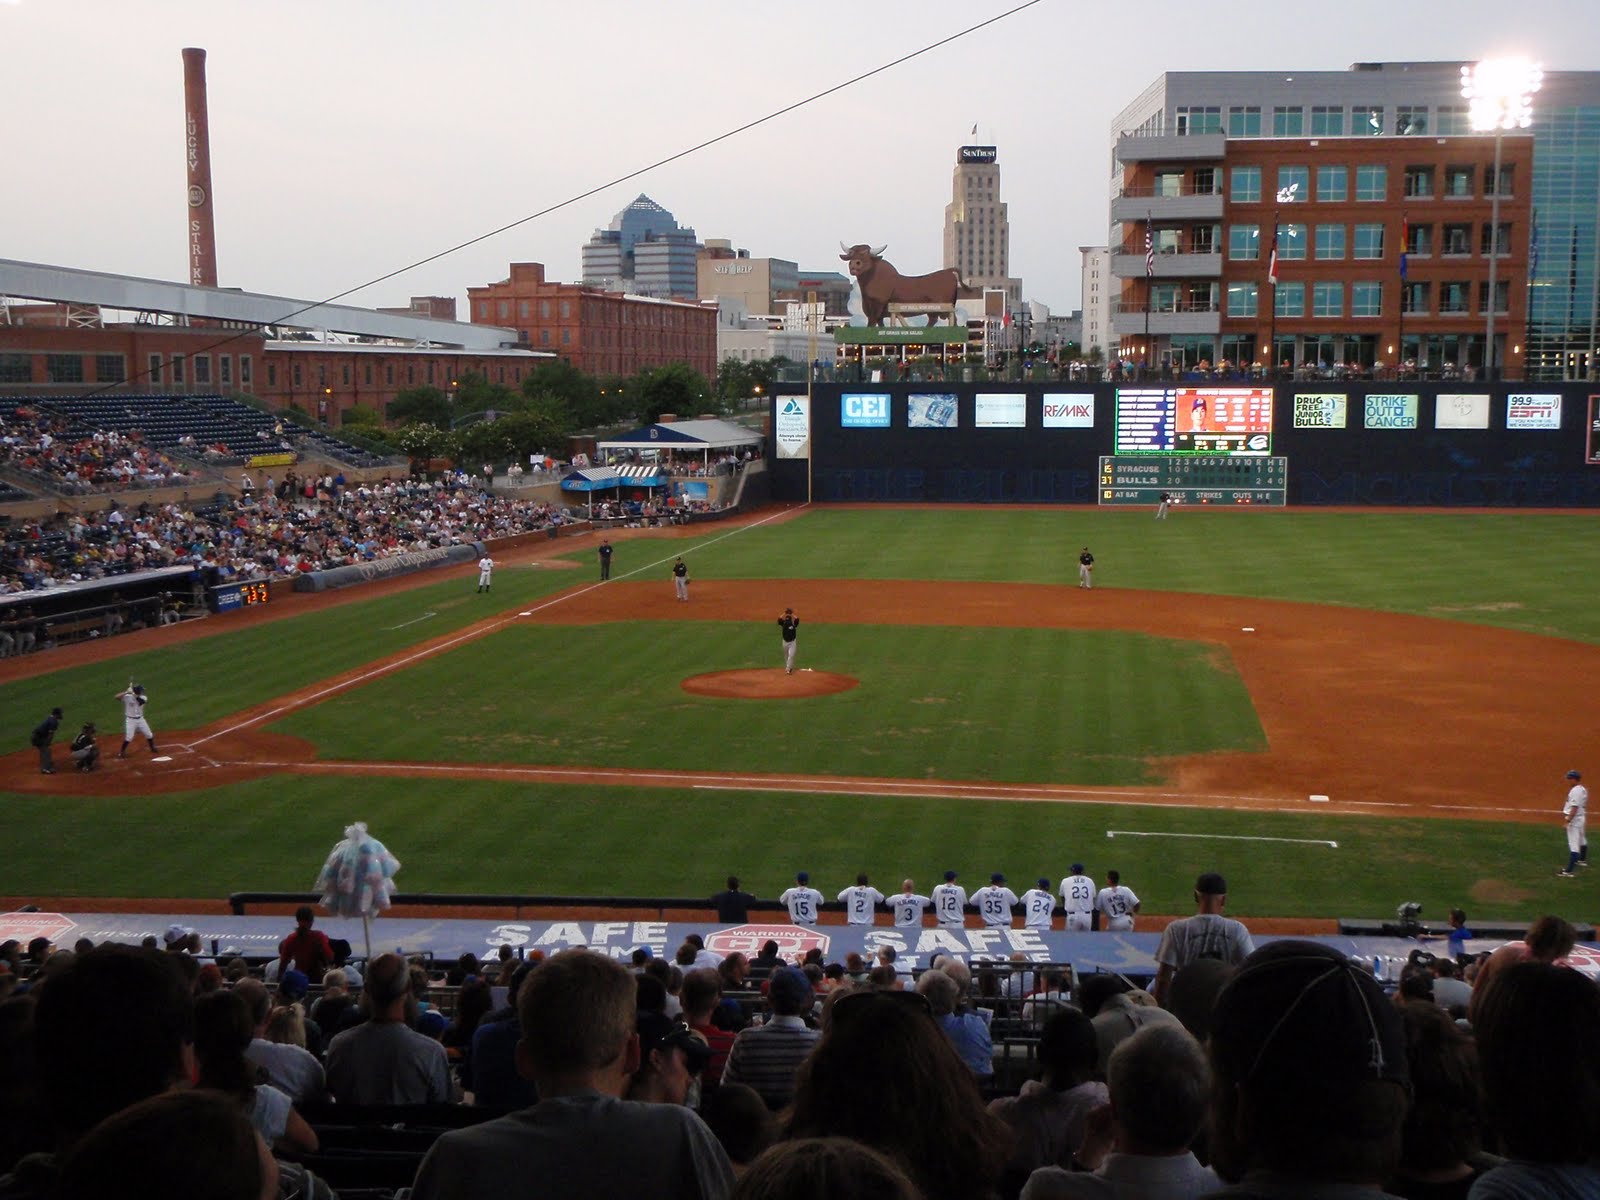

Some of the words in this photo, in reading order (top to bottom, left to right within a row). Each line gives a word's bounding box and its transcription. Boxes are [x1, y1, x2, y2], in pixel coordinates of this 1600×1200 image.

[187, 112, 198, 171] LUCKY
[846, 396, 886, 418] CEI
[1366, 396, 1407, 407] STRIKE
[1511, 397, 1532, 406] 99.9
[1044, 404, 1089, 417] RE/MAX
[1366, 406, 1394, 417] OUT
[1509, 406, 1552, 418] ESPN
[1295, 418, 1324, 426] BULLS
[1366, 416, 1415, 427] CANCER
[1072, 886, 1089, 899] 23
[795, 901, 809, 916] 15
[856, 900, 864, 913] 2
[942, 897, 956, 911] 12
[985, 900, 1002, 914] 35
[1033, 899, 1050, 915] 24
[1112, 902, 1126, 915] 13
[905, 908, 913, 921] 3
[486, 922, 668, 946] SAFE
[864, 929, 1049, 953] SAFE
